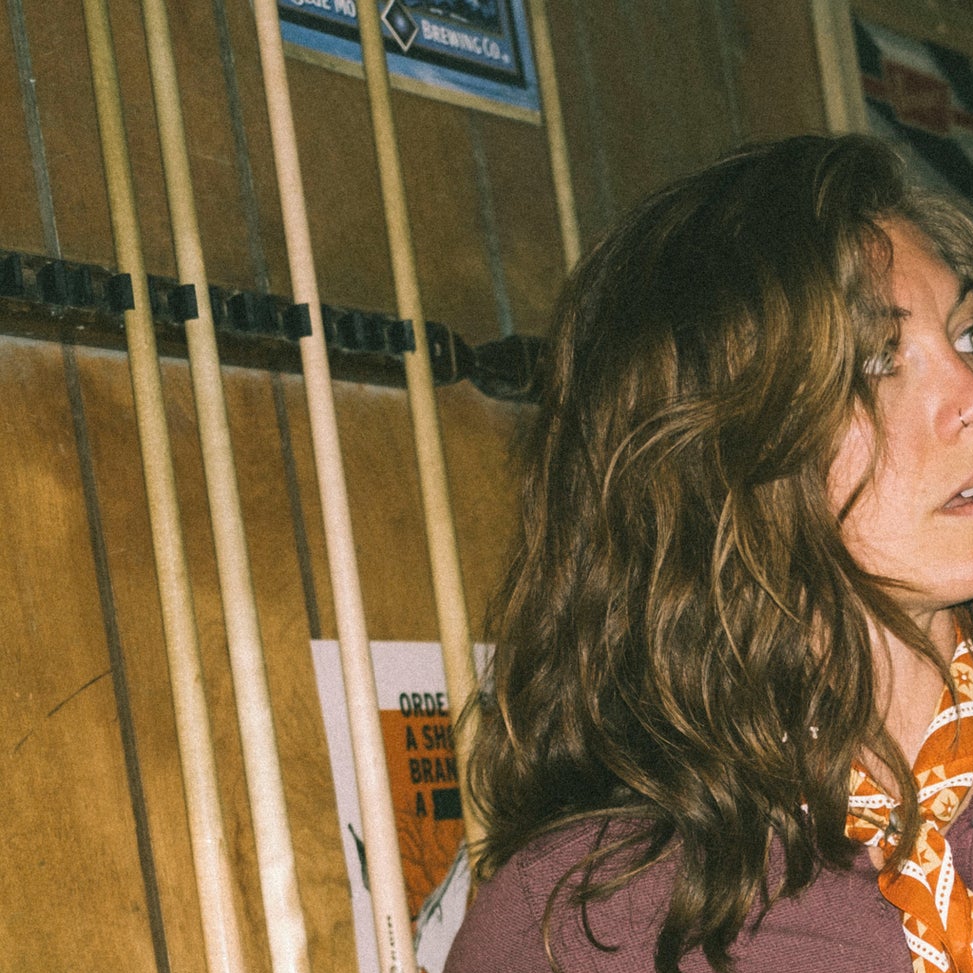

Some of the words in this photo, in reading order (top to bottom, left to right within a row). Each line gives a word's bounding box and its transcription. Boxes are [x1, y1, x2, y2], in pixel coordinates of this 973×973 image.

[421, 19, 482, 55] BREWING
[399, 692, 449, 717] ORDE
[405, 725, 418, 751] A
[421, 724, 456, 751] SHO
[408, 757, 459, 785] BRAN
[415, 791, 427, 817] A
